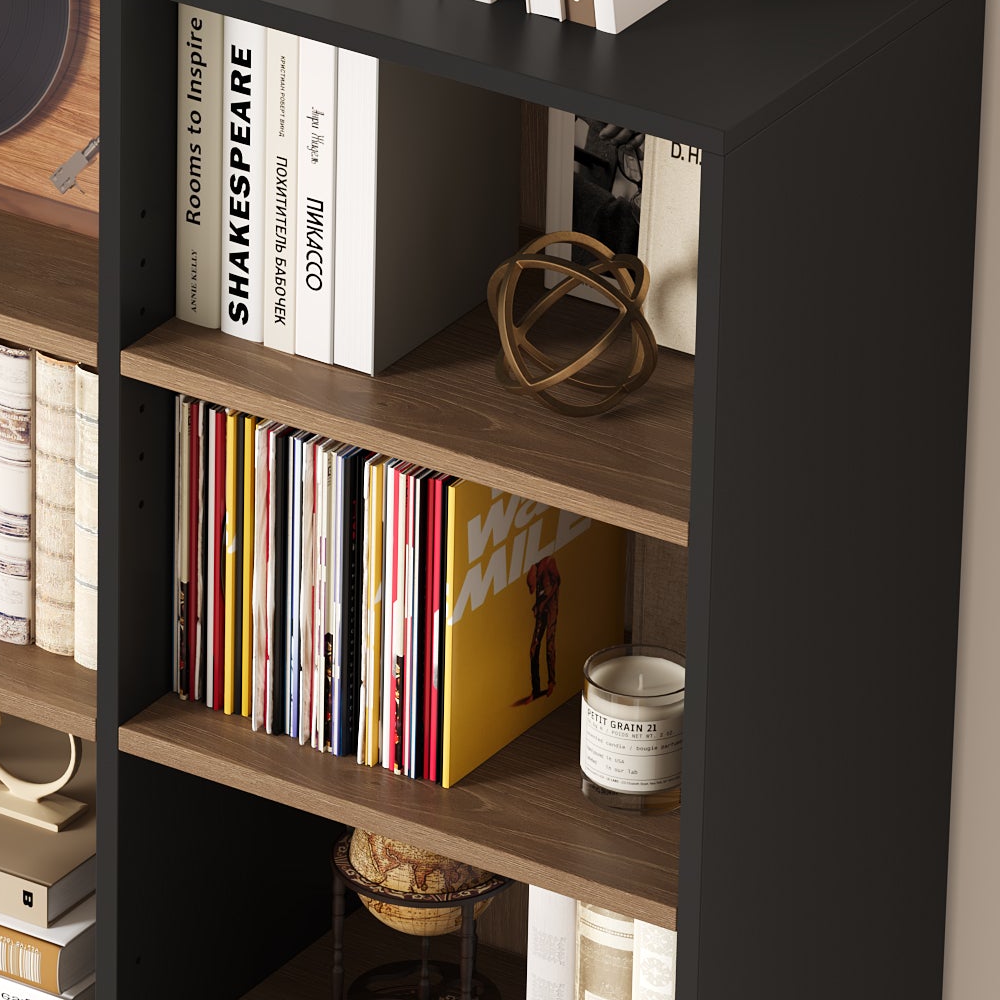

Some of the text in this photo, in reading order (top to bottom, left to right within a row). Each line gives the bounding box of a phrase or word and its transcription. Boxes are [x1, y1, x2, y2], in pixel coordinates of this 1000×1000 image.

[185, 16, 208, 226] Rooms to Inspire
[228, 45, 251, 326] SHAKESPEARE
[190, 249, 198, 312] ANNIE KELLY
[273, 155, 288, 327] ПОХИТИТЕЛЬ БАБОЧЕК
[305, 197, 324, 292] ПИКАССО
[587, 708, 607, 725] PETIT
[610, 720, 643, 732] GRAIN
[647, 724, 657, 732] 21
